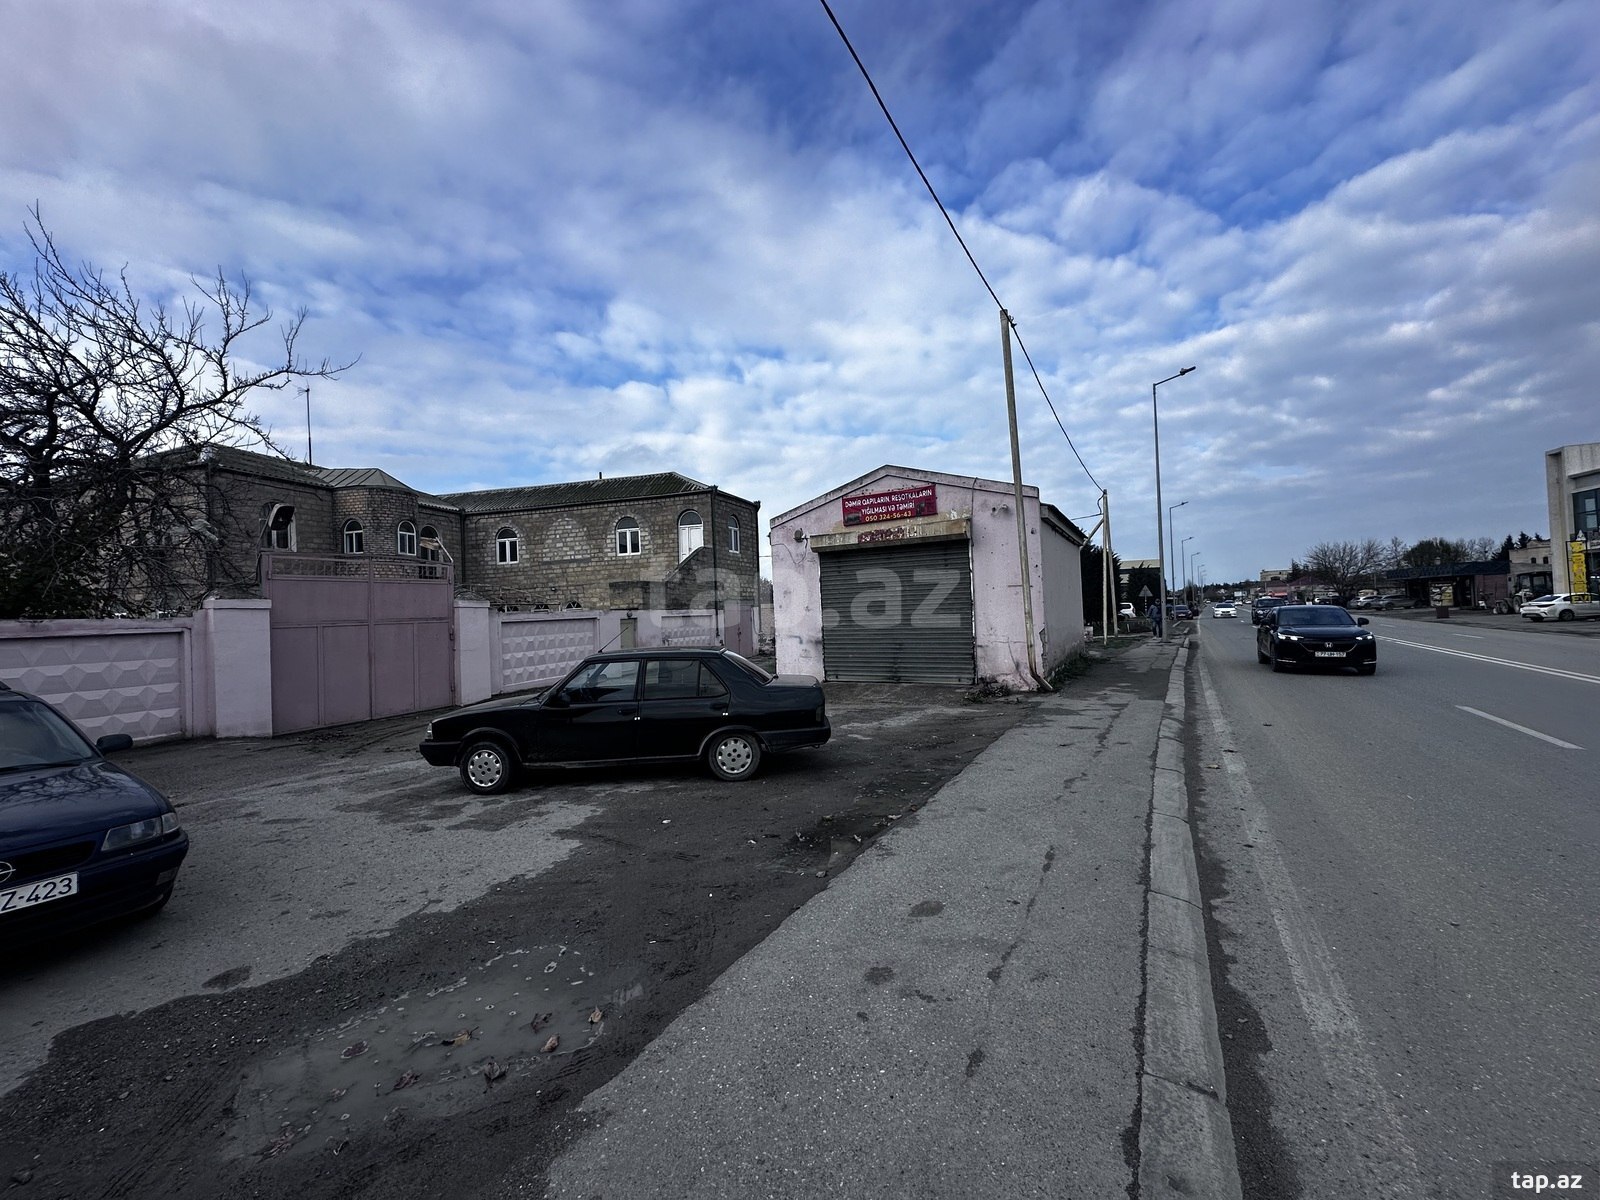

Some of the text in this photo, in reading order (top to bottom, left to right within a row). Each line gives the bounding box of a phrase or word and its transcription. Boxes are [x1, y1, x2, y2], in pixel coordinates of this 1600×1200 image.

[845, 499, 861, 508] DƏMİR
[861, 505, 887, 515] YIĞILMASI
[896, 500, 915, 511] TƏMİRİ
[879, 510, 912, 521] 324-56-43
